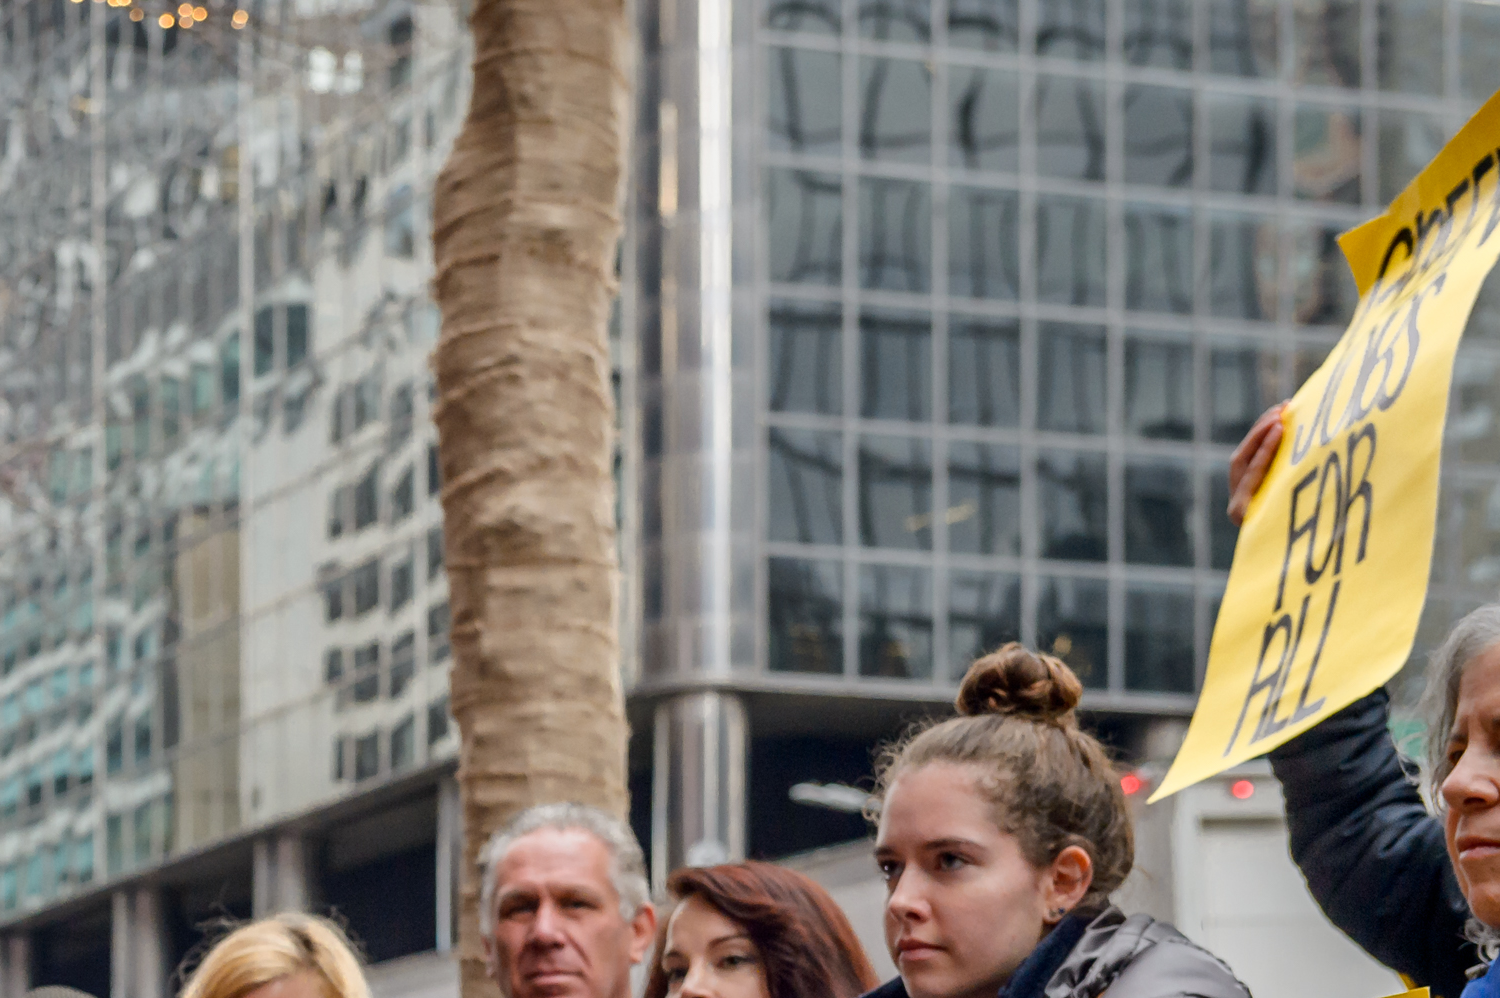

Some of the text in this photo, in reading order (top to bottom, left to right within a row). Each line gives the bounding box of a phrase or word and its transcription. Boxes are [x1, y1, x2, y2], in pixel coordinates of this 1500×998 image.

[1290, 272, 1448, 466] JOBS
[1274, 422, 1376, 614] FOR
[1222, 578, 1341, 758] ALL
